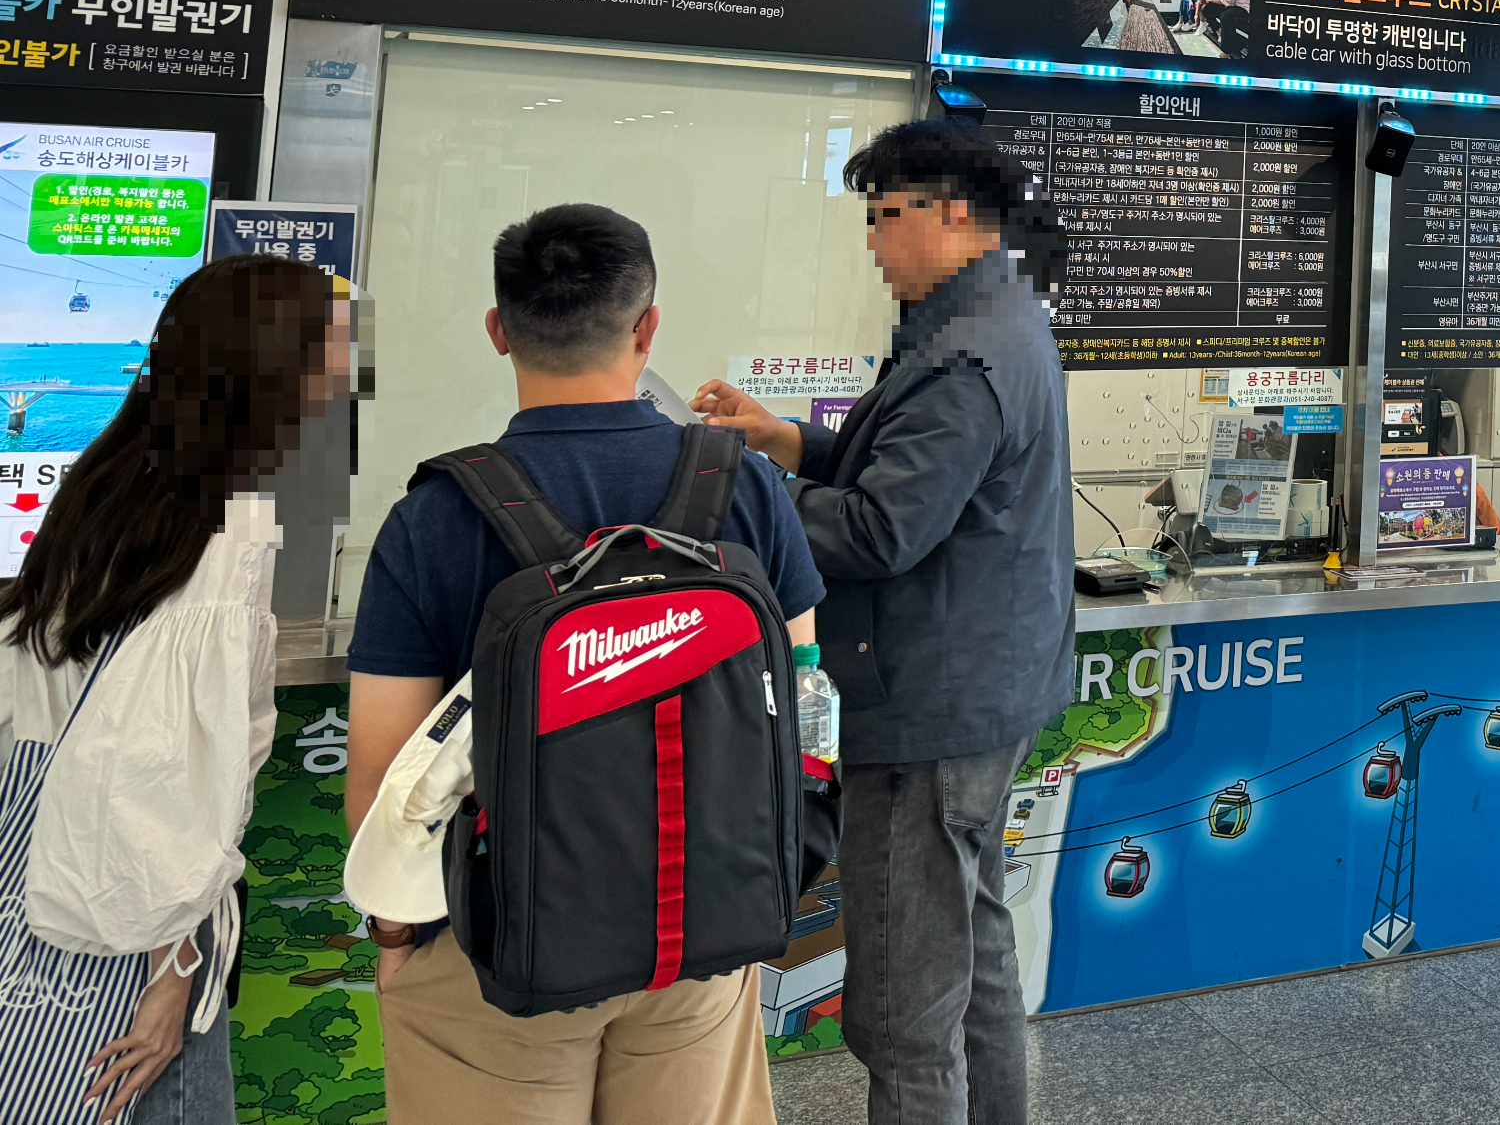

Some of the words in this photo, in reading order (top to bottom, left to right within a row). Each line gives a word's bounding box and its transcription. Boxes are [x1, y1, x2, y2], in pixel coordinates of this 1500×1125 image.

[1268, 14, 1320, 39] 바닥이
[1326, 19, 1378, 44] 투명한
[1383, 25, 1466, 52] 캐빈입니다
[1266, 42, 1307, 59] cable
[1312, 48, 1335, 62] car
[1339, 48, 1371, 65] with
[1376, 50, 1413, 70] glass
[1418, 54, 1470, 73] bottom
[1140, 94, 1200, 116] 할인안내
[1057, 117, 1075, 126] 20인
[1078, 118, 1093, 127] 이상
[1097, 119, 1111, 128] 적용
[39, 135, 81, 145] BUSAN
[83, 137, 103, 146] AIR
[106, 138, 150, 148] CRUISE
[37, 150, 189, 172] 송도해상케이블카
[235, 220, 334, 240] 무인발권기
[252, 242, 289, 257] 사용
[297, 243, 316, 260] 중
[750, 357, 852, 375] 용궁구름다리
[1247, 370, 1324, 386] 용궁구름다리
[1396, 468, 1420, 483] 소원의
[1423, 467, 1432, 482] 등
[1434, 469, 1450, 481] 판매
[557, 608, 704, 676] Milwaukee
[1127, 636, 1304, 698] CRUISE
[436, 705, 458, 730] POLO
